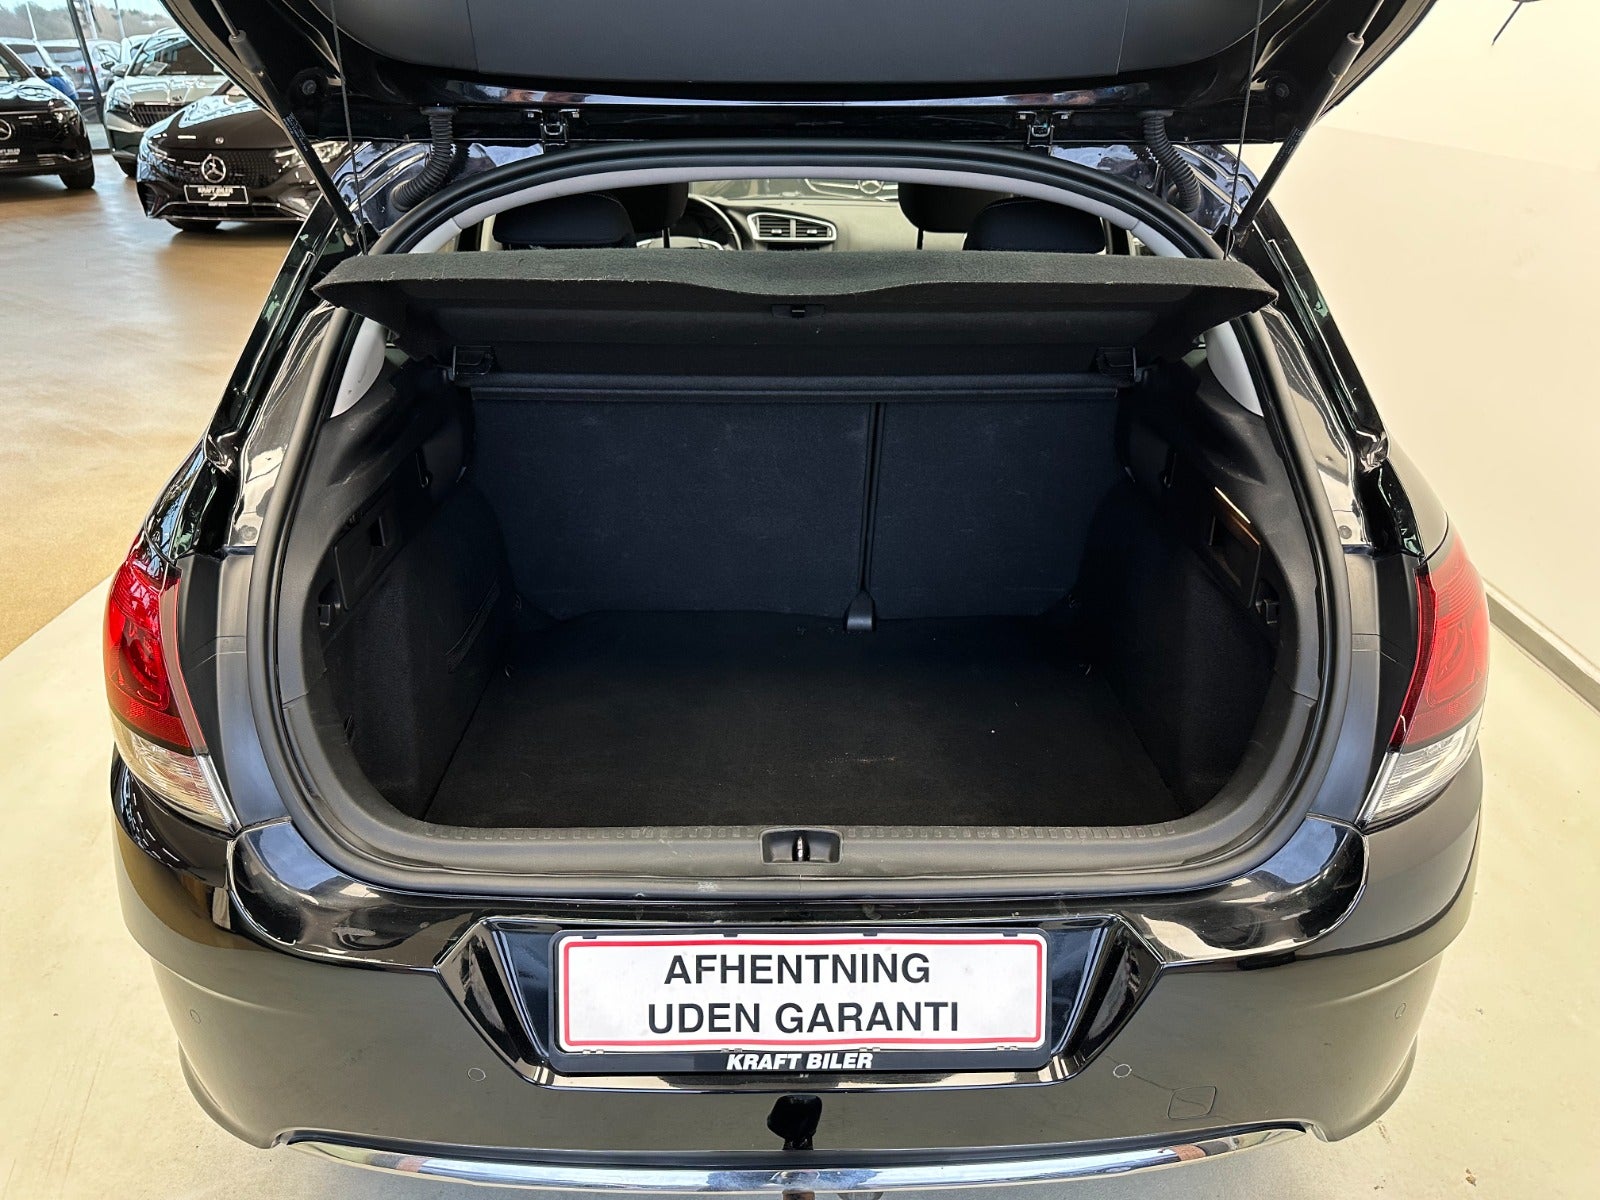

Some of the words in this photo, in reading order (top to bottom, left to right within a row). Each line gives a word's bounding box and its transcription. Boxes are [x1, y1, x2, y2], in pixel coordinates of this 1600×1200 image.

[664, 952, 930, 985] AFHENTNING
[648, 1002, 760, 1034] UDEN
[775, 1001, 958, 1034] GARANTI
[726, 1053, 802, 1070] KRAFT
[806, 1052, 873, 1070] BILER
